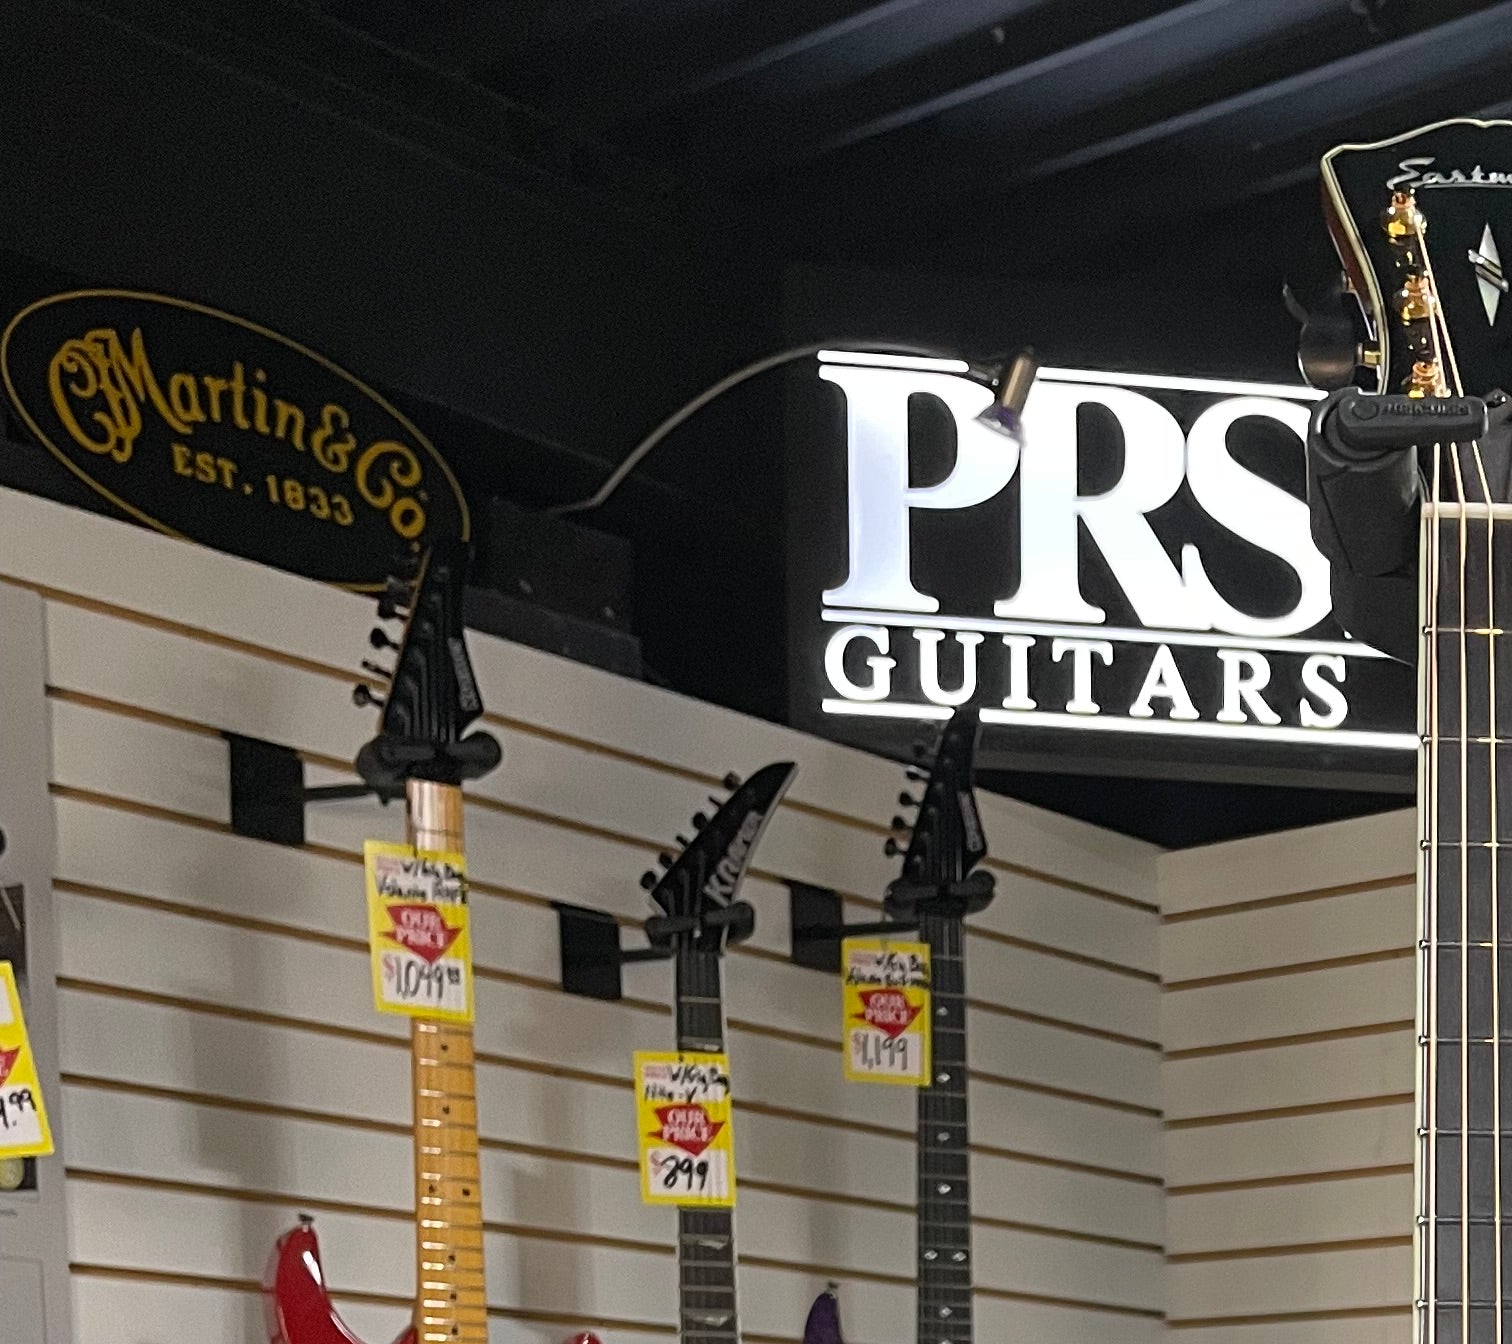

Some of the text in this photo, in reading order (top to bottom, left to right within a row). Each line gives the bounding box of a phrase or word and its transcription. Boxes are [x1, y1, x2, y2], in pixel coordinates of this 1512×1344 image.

[266, 474, 355, 527] 1833
[818, 364, 1333, 638] PRS
[824, 625, 1349, 730] GUITARS
